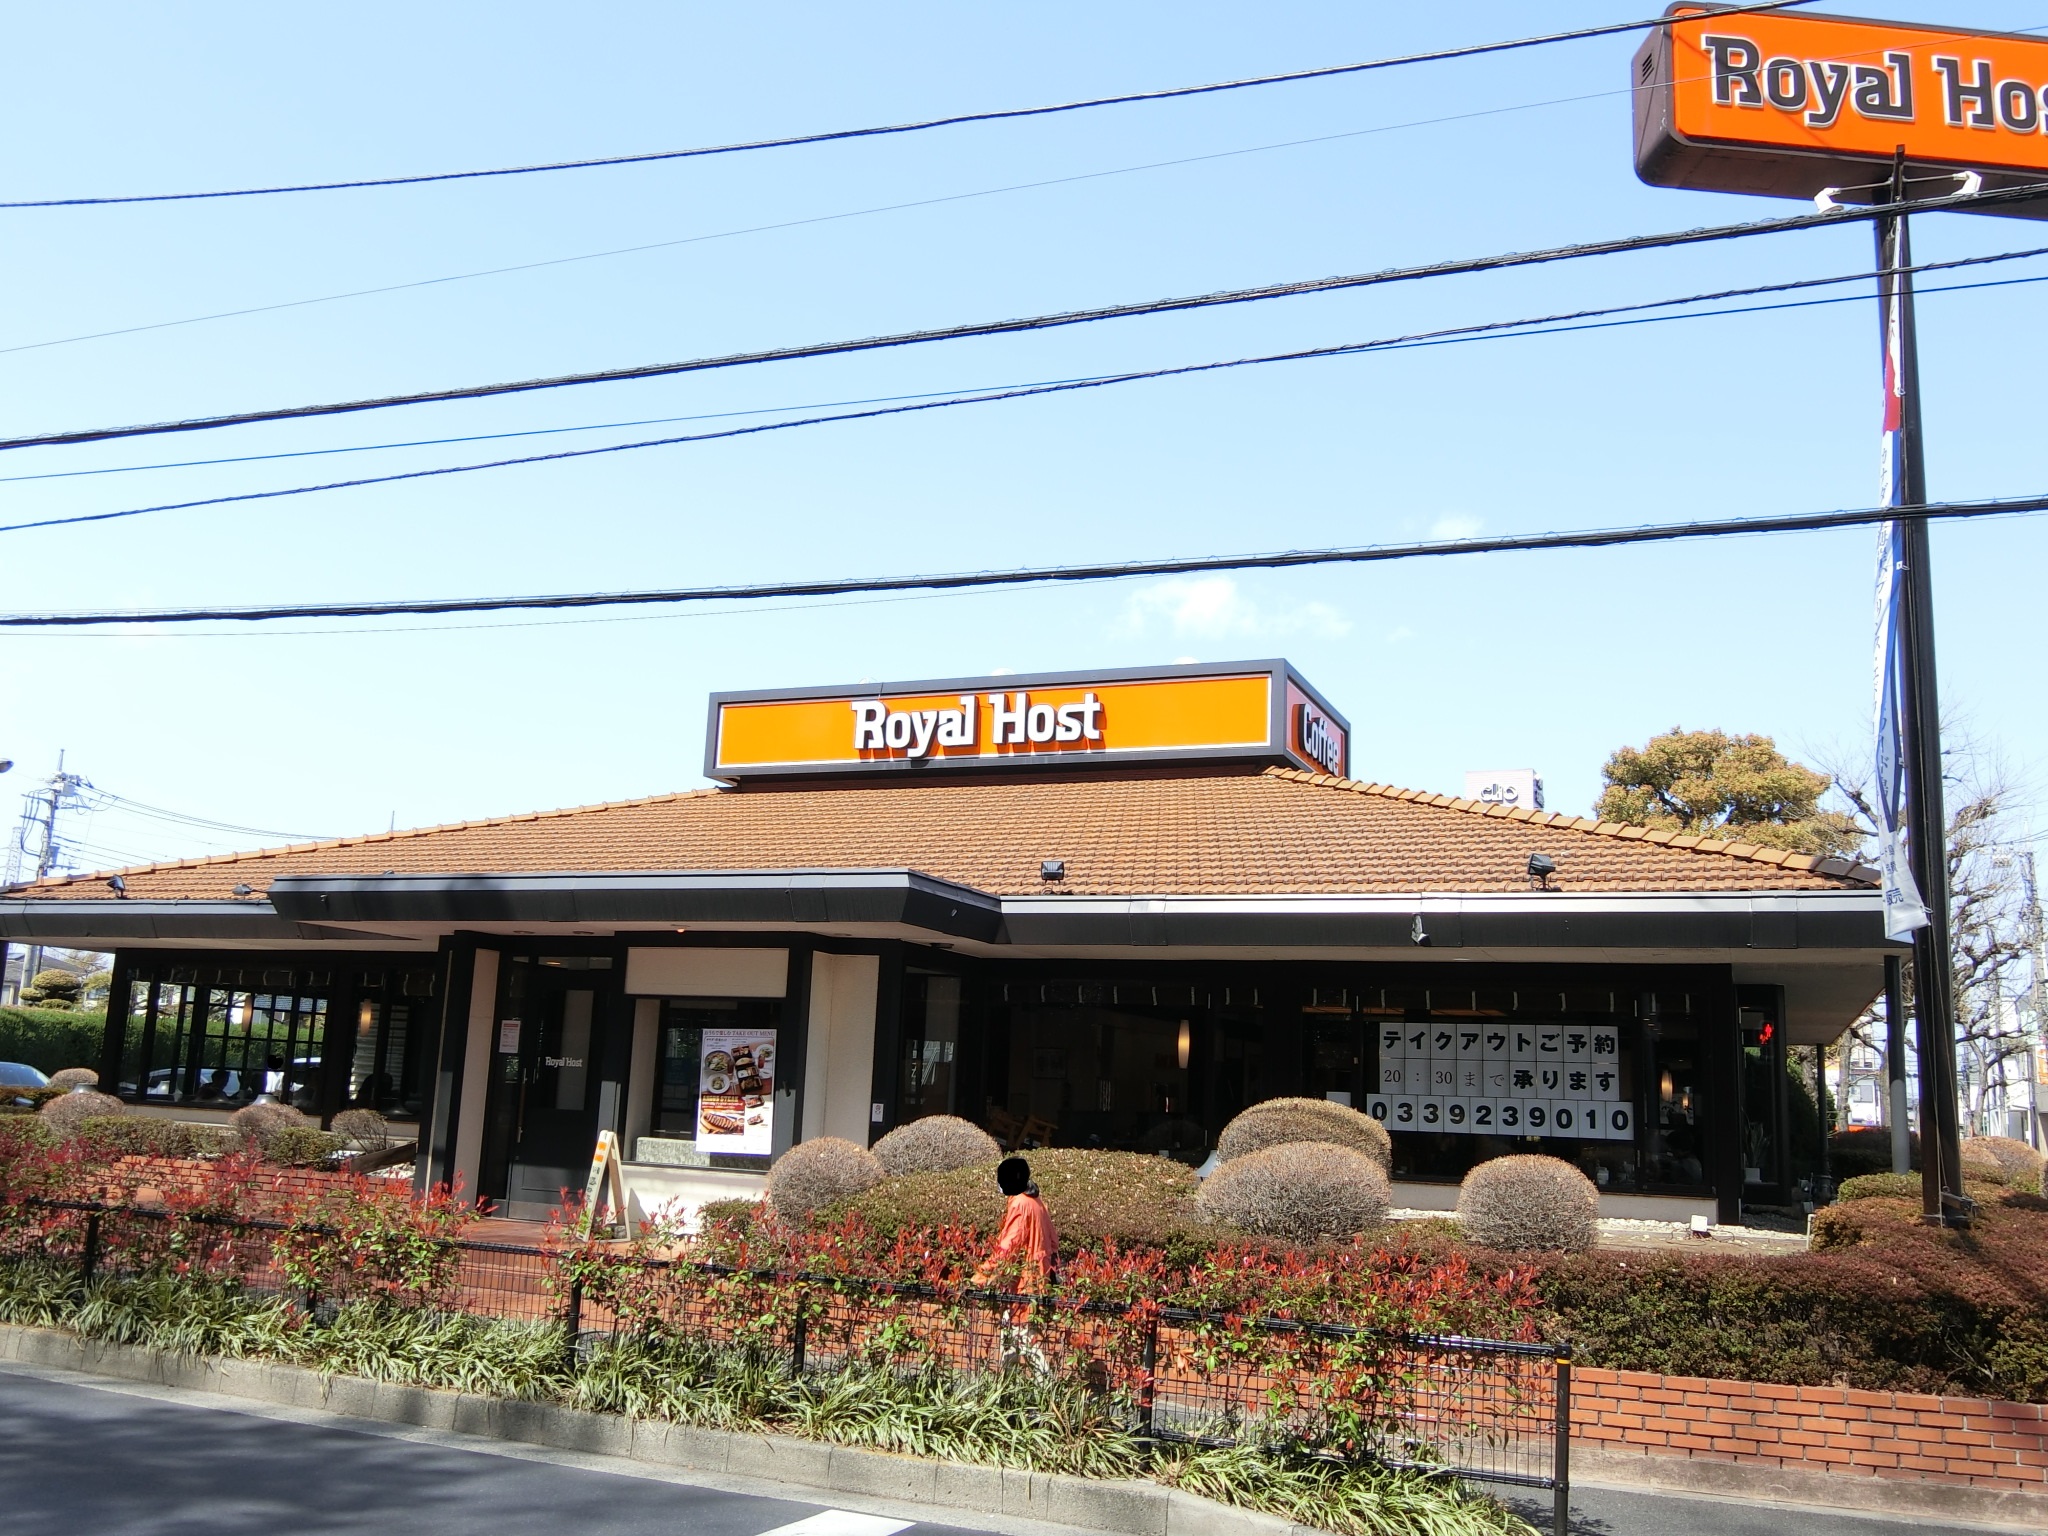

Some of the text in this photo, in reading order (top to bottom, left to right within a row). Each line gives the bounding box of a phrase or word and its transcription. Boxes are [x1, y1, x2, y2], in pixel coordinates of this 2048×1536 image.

[1701, 33, 2048, 135] Royal Ho
[851, 692, 1102, 758] Royal Host
[1303, 703, 1339, 776] Coffee
[545, 1057, 583, 1067] Royal Host
[1383, 1030, 1616, 1055] テイクアウトご予約
[1371, 1101, 1629, 1131] 0339239010
